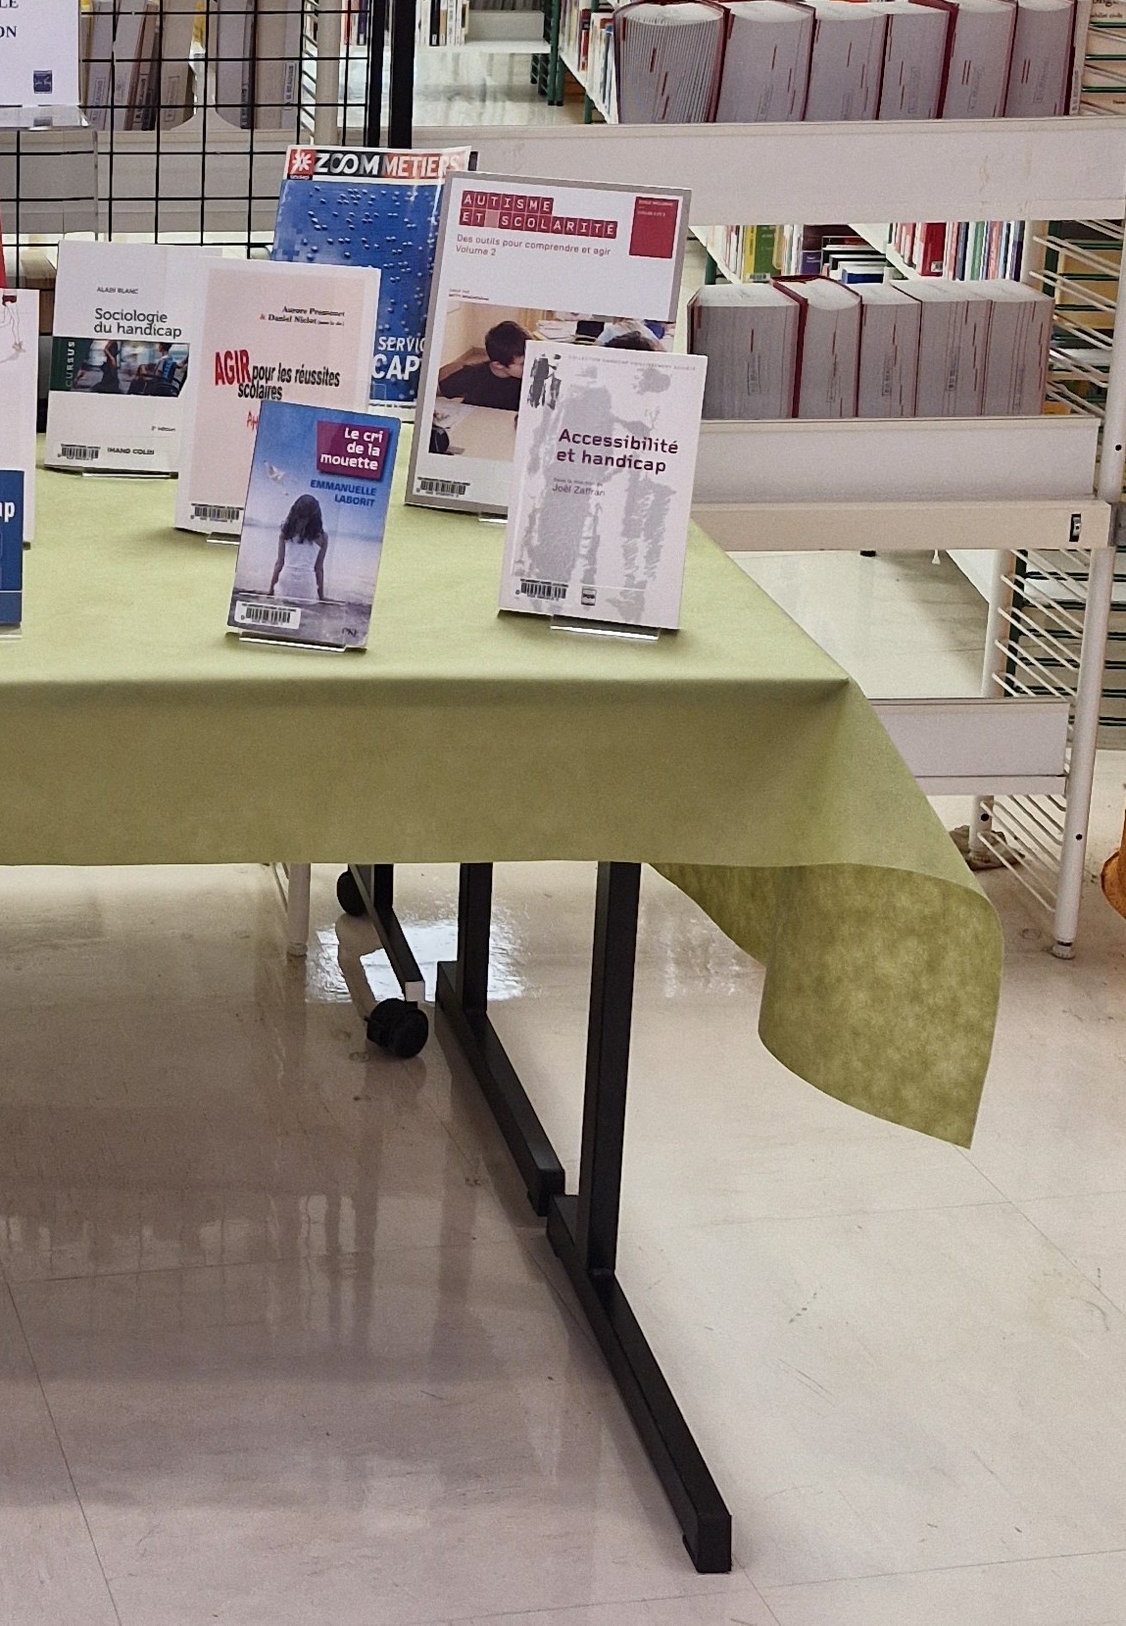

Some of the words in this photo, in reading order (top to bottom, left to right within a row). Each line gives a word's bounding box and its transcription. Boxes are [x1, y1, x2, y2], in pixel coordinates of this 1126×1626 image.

[314, 152, 379, 175] ZOOM
[464, 195, 550, 211] AUTISME
[462, 211, 483, 223] ET
[456, 245, 488, 255] Volume
[491, 248, 496, 256] 2
[457, 234, 473, 243] Des
[475, 235, 500, 246] outils
[503, 238, 523, 248] pour
[525, 240, 579, 253] comprendre
[581, 245, 591, 253] et
[594, 247, 611, 256] agir
[95, 308, 168, 324] Sociologie
[94, 321, 112, 333] du
[117, 322, 182, 338] handicap
[378, 336, 426, 353] SERVIC
[65, 341, 76, 387] CURSUS
[215, 349, 251, 386] AGIR
[251, 365, 275, 384] pour
[277, 362, 292, 383] les
[295, 363, 340, 387] réussites
[238, 379, 282, 400] scolaires
[345, 428, 359, 440] Le
[363, 430, 383, 443] cri
[558, 429, 678, 454] Accessibilité
[347, 443, 363, 454] de
[368, 446, 380, 456] la
[320, 454, 378, 470] mouette
[556, 448, 575, 462] et
[582, 450, 666, 475] handicap
[310, 479, 377, 496] EMMANUELLE
[552, 485, 571, 493] Joël
[574, 486, 605, 496] Zaffran
[335, 494, 375, 507] LABORIT
